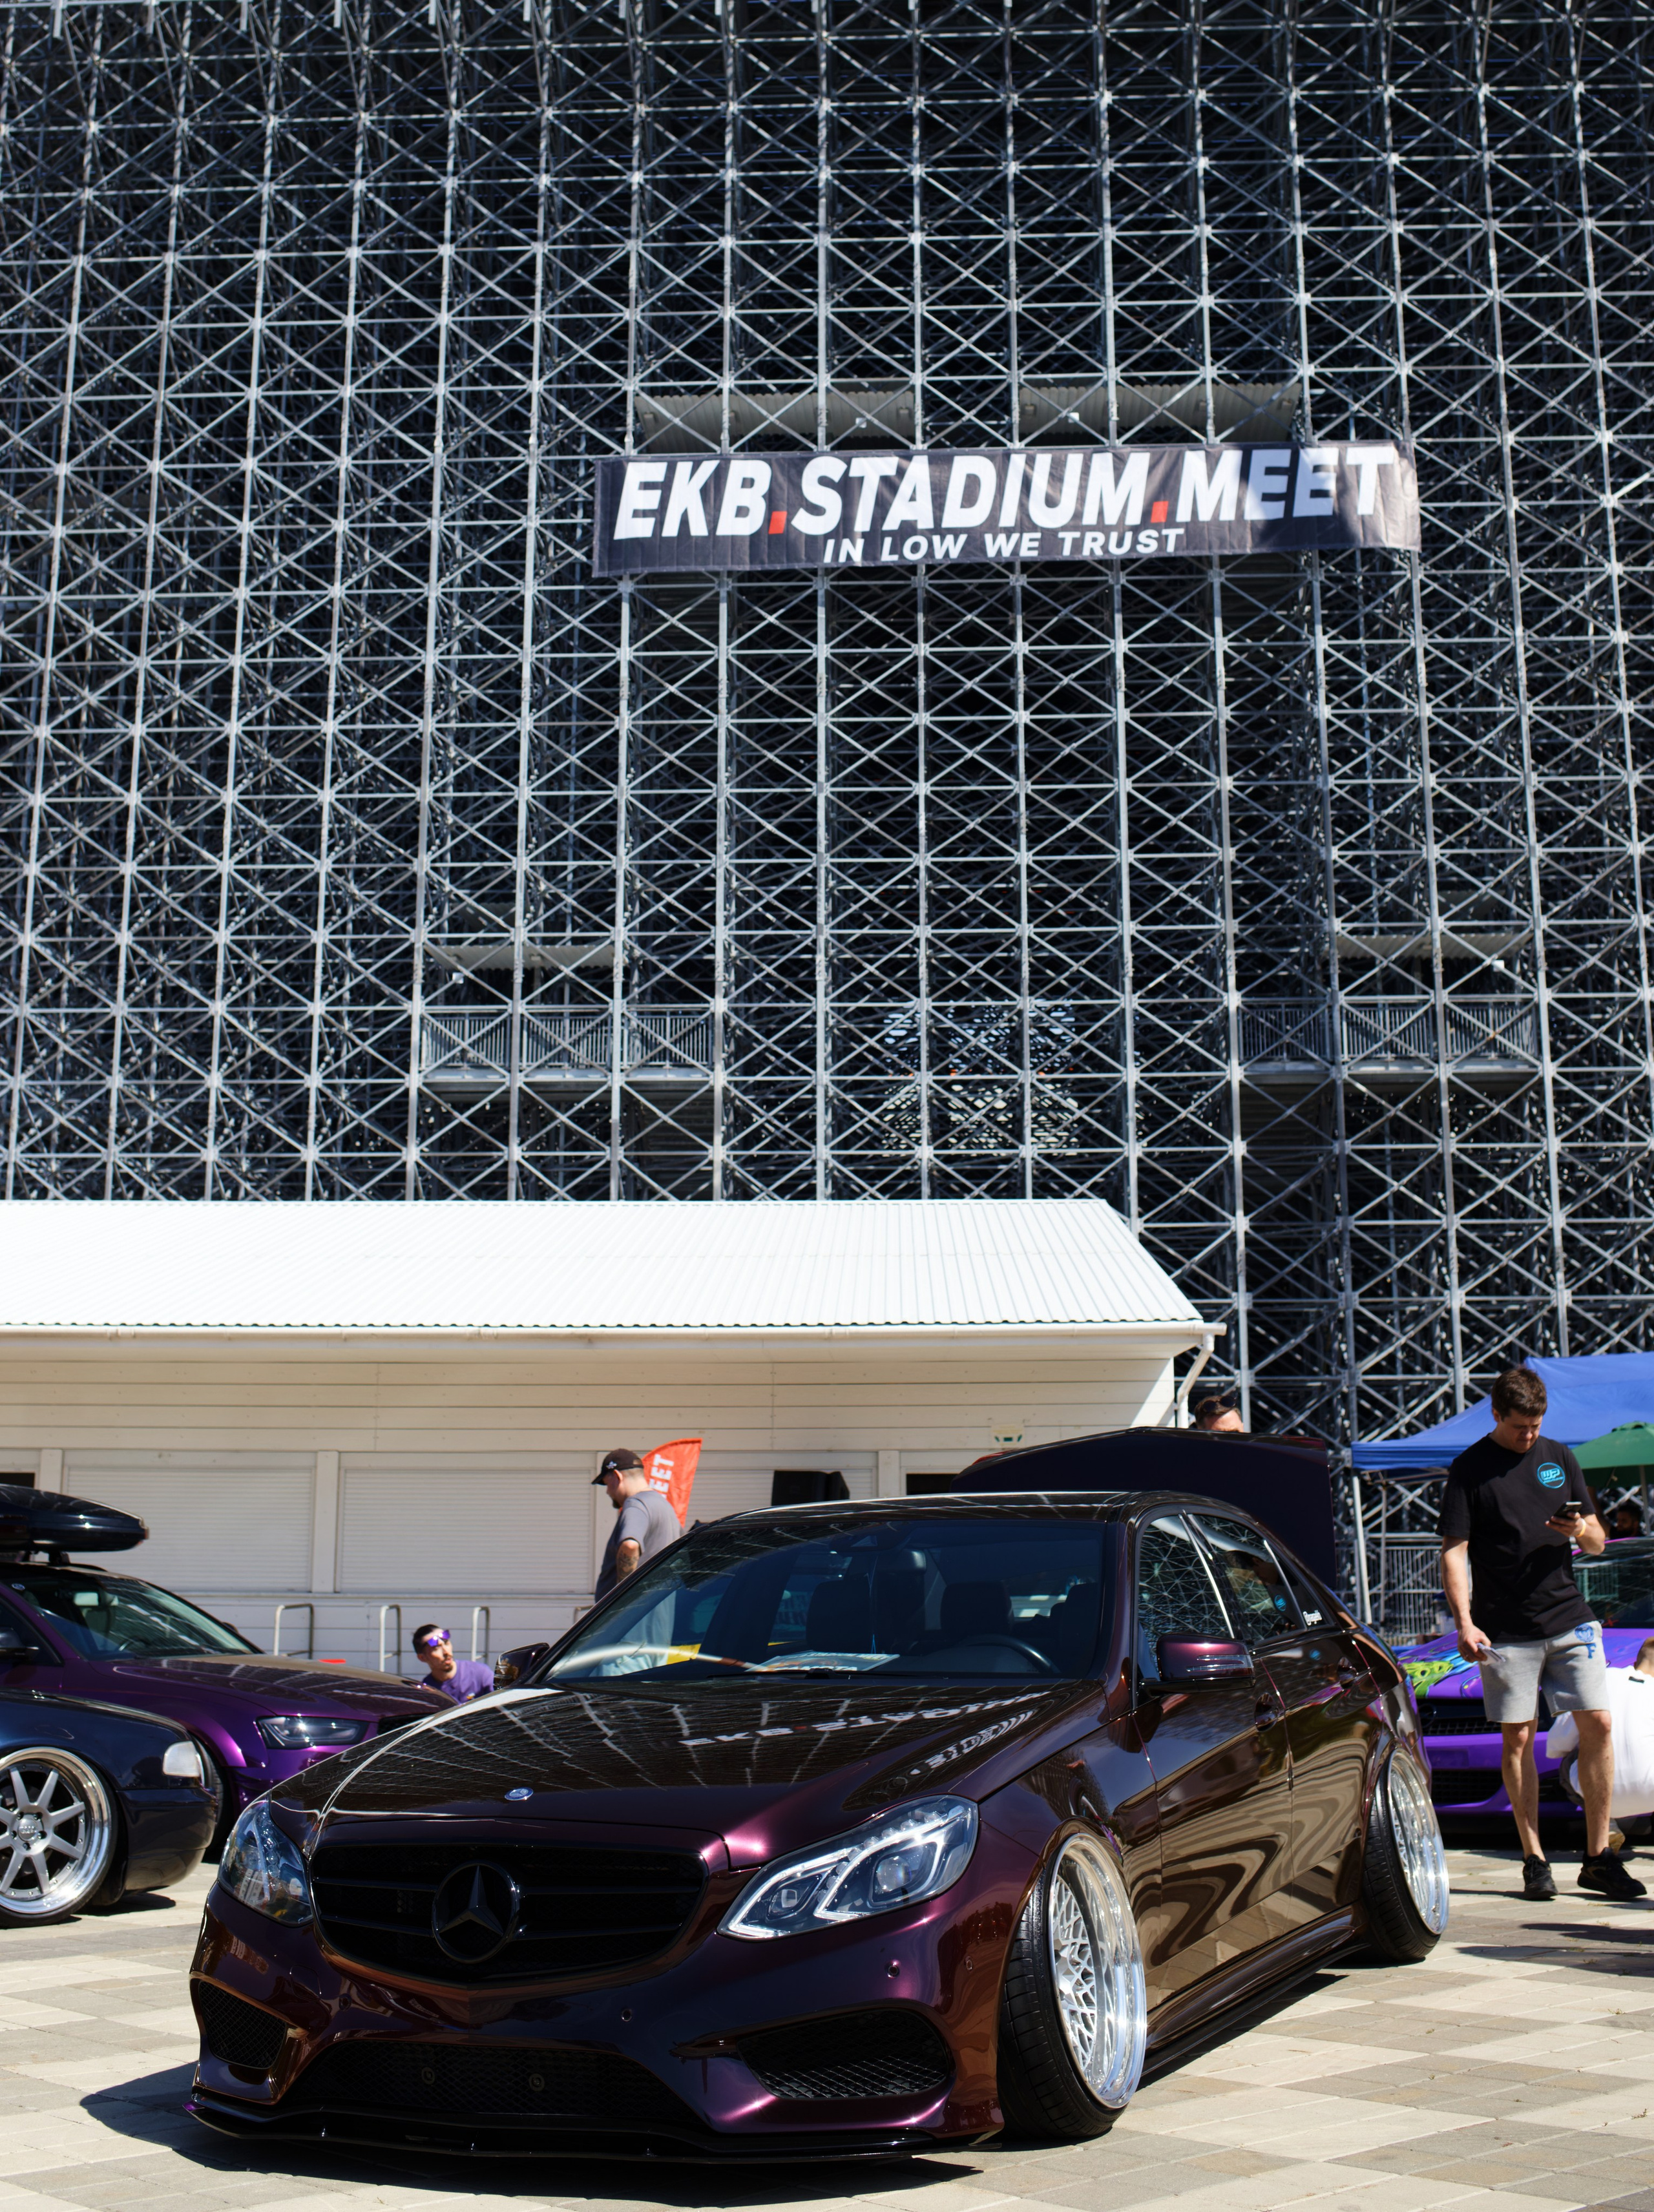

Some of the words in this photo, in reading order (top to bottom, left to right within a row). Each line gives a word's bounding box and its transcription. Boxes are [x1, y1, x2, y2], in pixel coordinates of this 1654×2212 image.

[824, 538, 864, 563] IN
[881, 534, 968, 561] LOW
[984, 532, 1042, 558] WE
[1058, 528, 1185, 557] TRUST
[649, 1454, 674, 1499] EET
